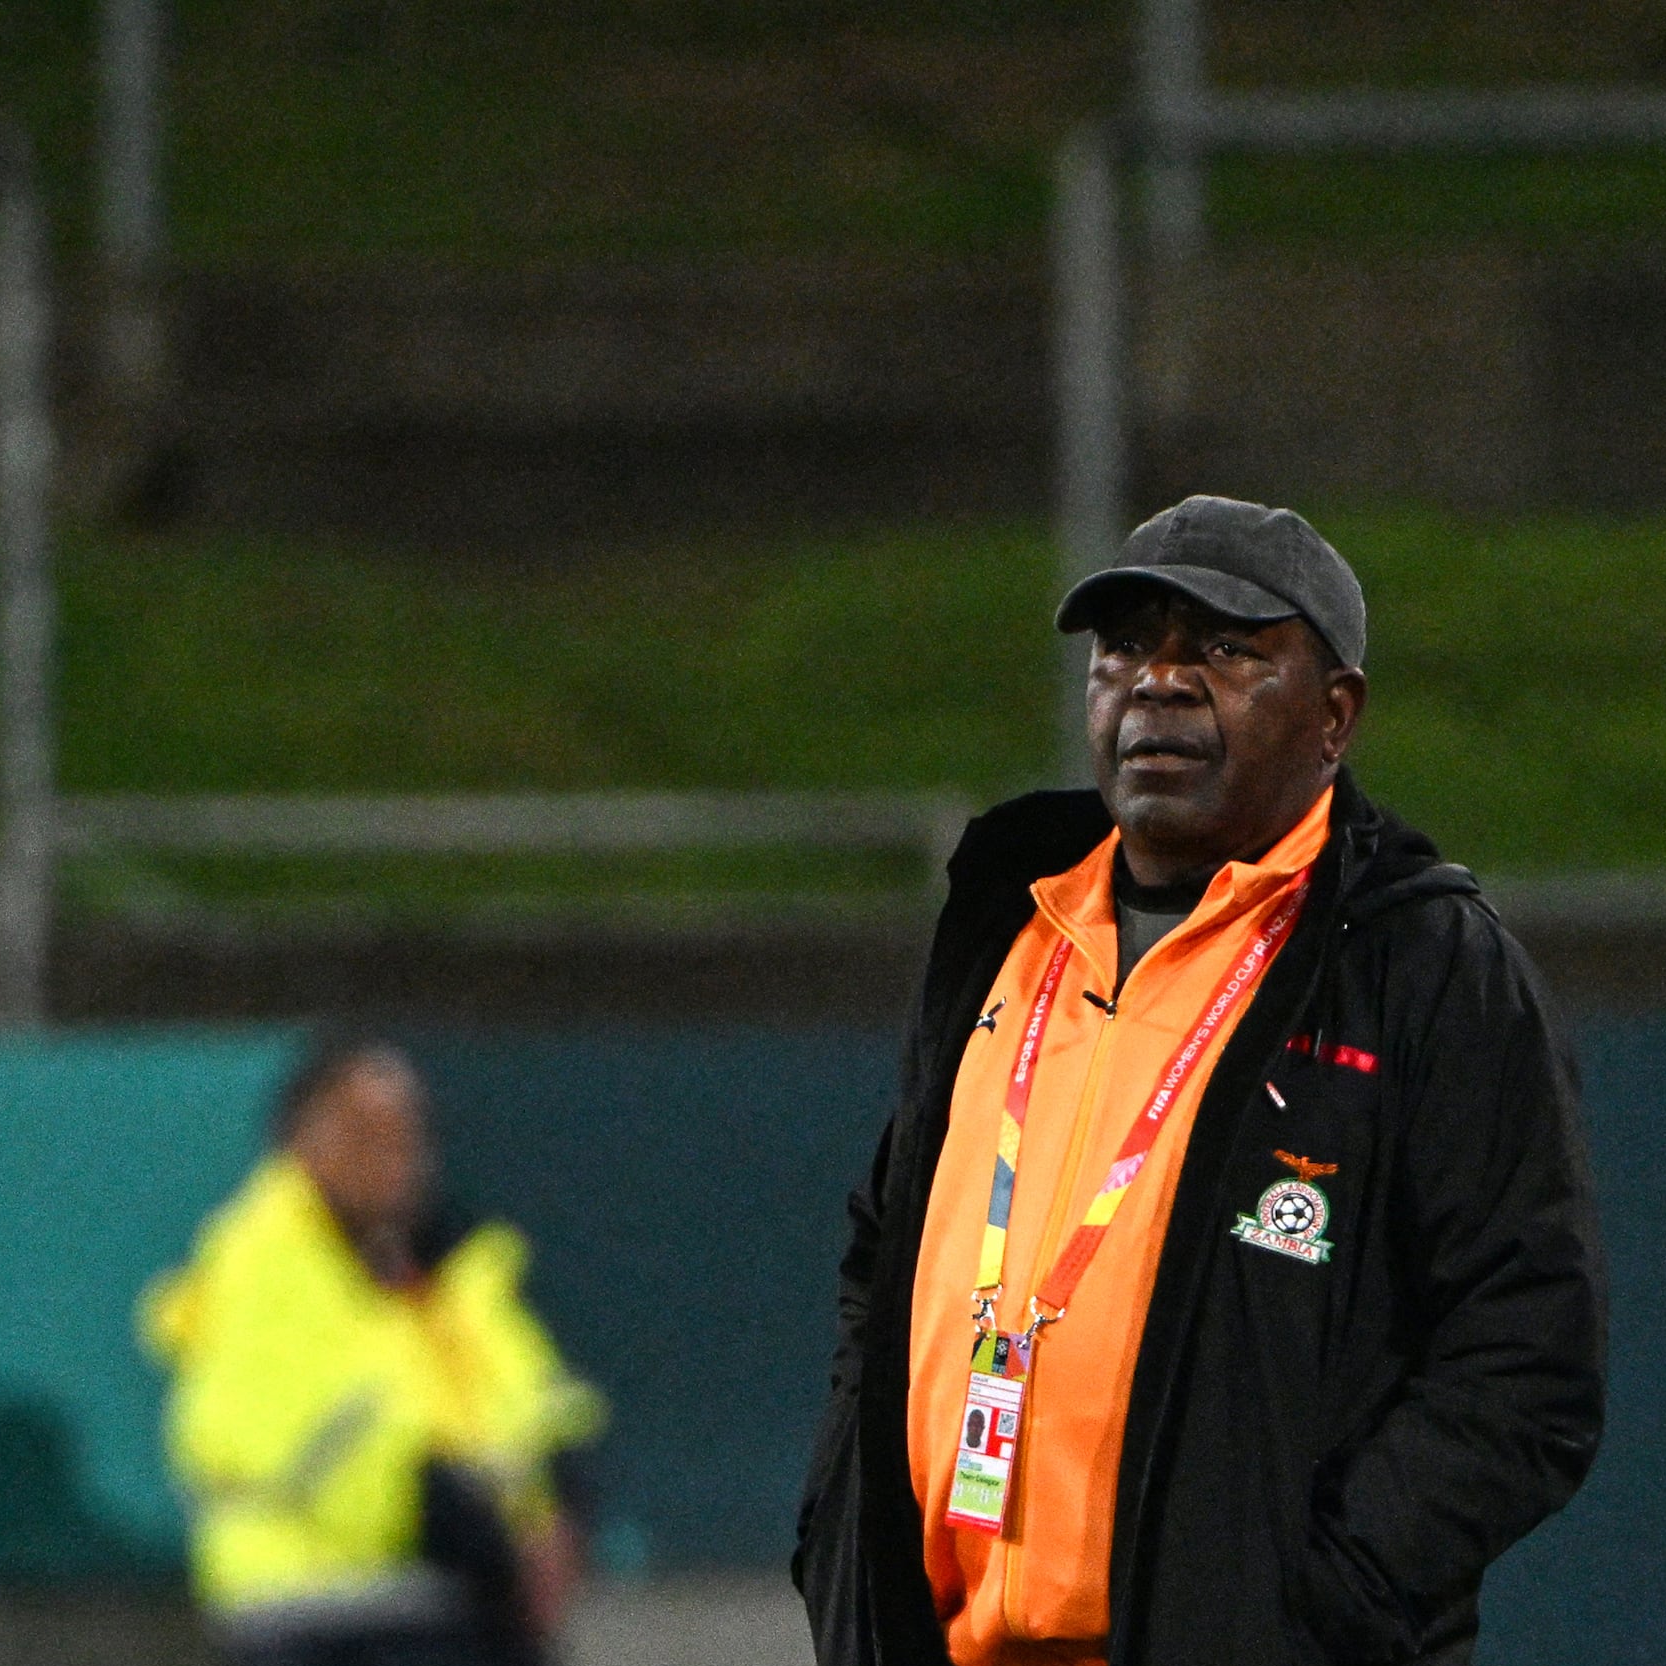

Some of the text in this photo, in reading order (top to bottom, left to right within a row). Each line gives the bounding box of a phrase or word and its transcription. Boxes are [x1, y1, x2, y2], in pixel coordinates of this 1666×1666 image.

[1146, 1089, 1172, 1120] FIFA
[1163, 1027, 1210, 1089] WOMEN'S
[1203, 980, 1240, 1027] WORLD
[1235, 953, 1257, 981] CUP
[1250, 1228, 1313, 1258] ZAMBIA
